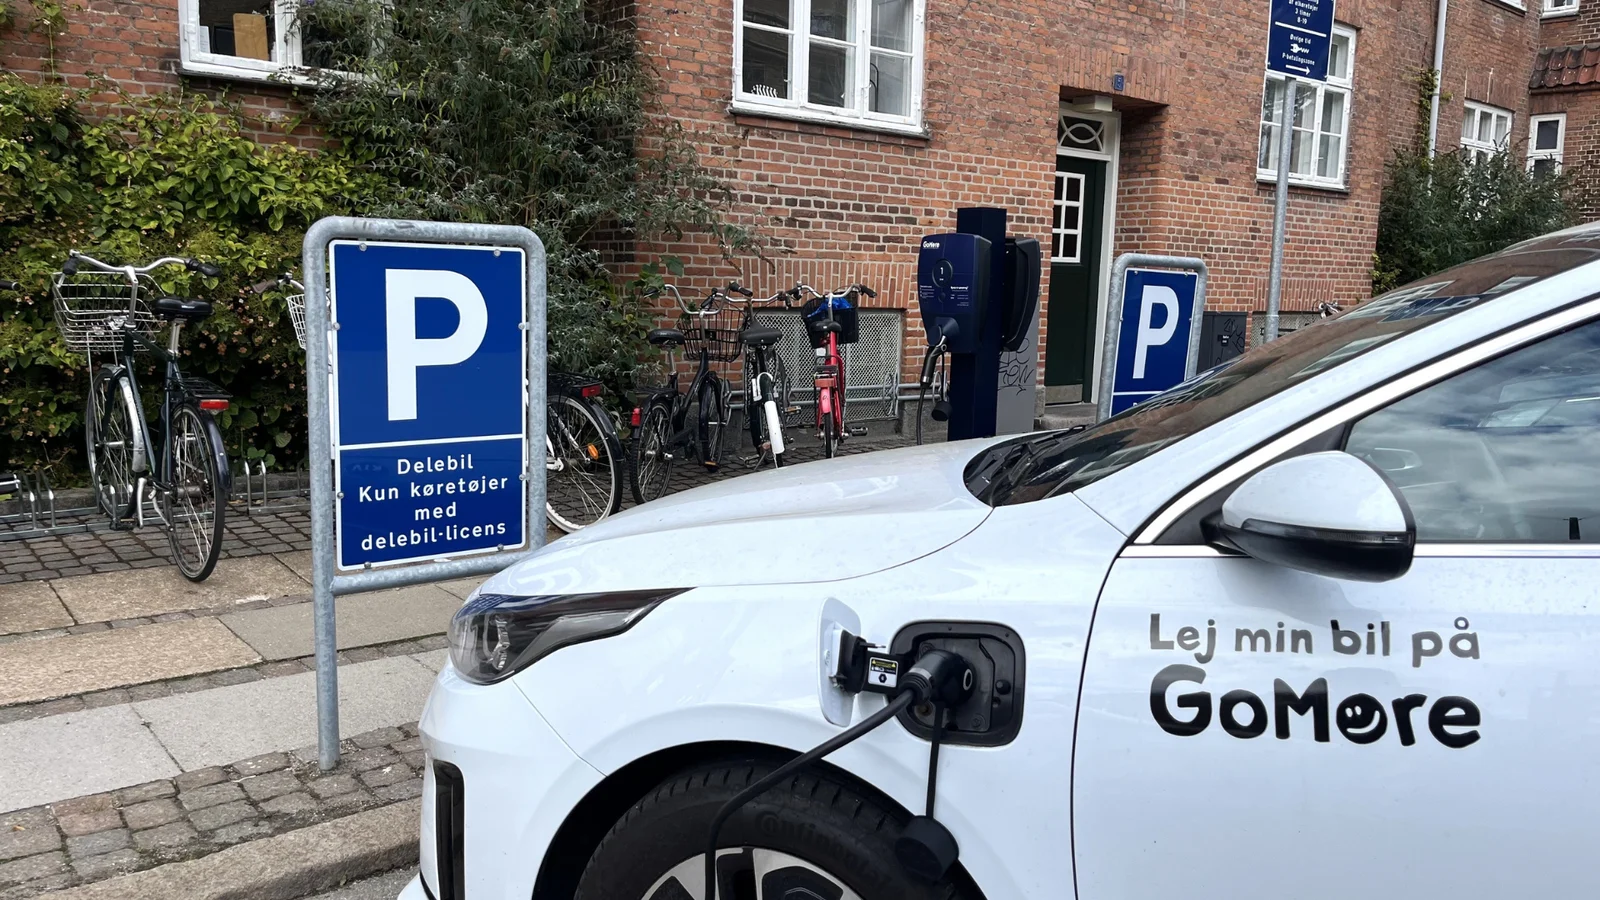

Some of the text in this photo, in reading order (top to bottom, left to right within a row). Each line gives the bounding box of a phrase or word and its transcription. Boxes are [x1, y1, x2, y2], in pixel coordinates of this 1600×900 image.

[1296, 16, 1308, 24] 8-19
[1300, 9, 1311, 18] timer
[1290, 34, 1304, 44] Øvrige
[1282, 52, 1315, 66] P-betalingszone
[1132, 285, 1179, 379] P
[385, 268, 488, 421] P
[397, 454, 474, 475] Delebil
[359, 477, 508, 502] Kun køretøjer
[414, 502, 457, 521] med
[361, 522, 506, 550] delebil-licens
[1150, 613, 1480, 668] Lej min bil på
[1149, 663, 1481, 749] GoMore
